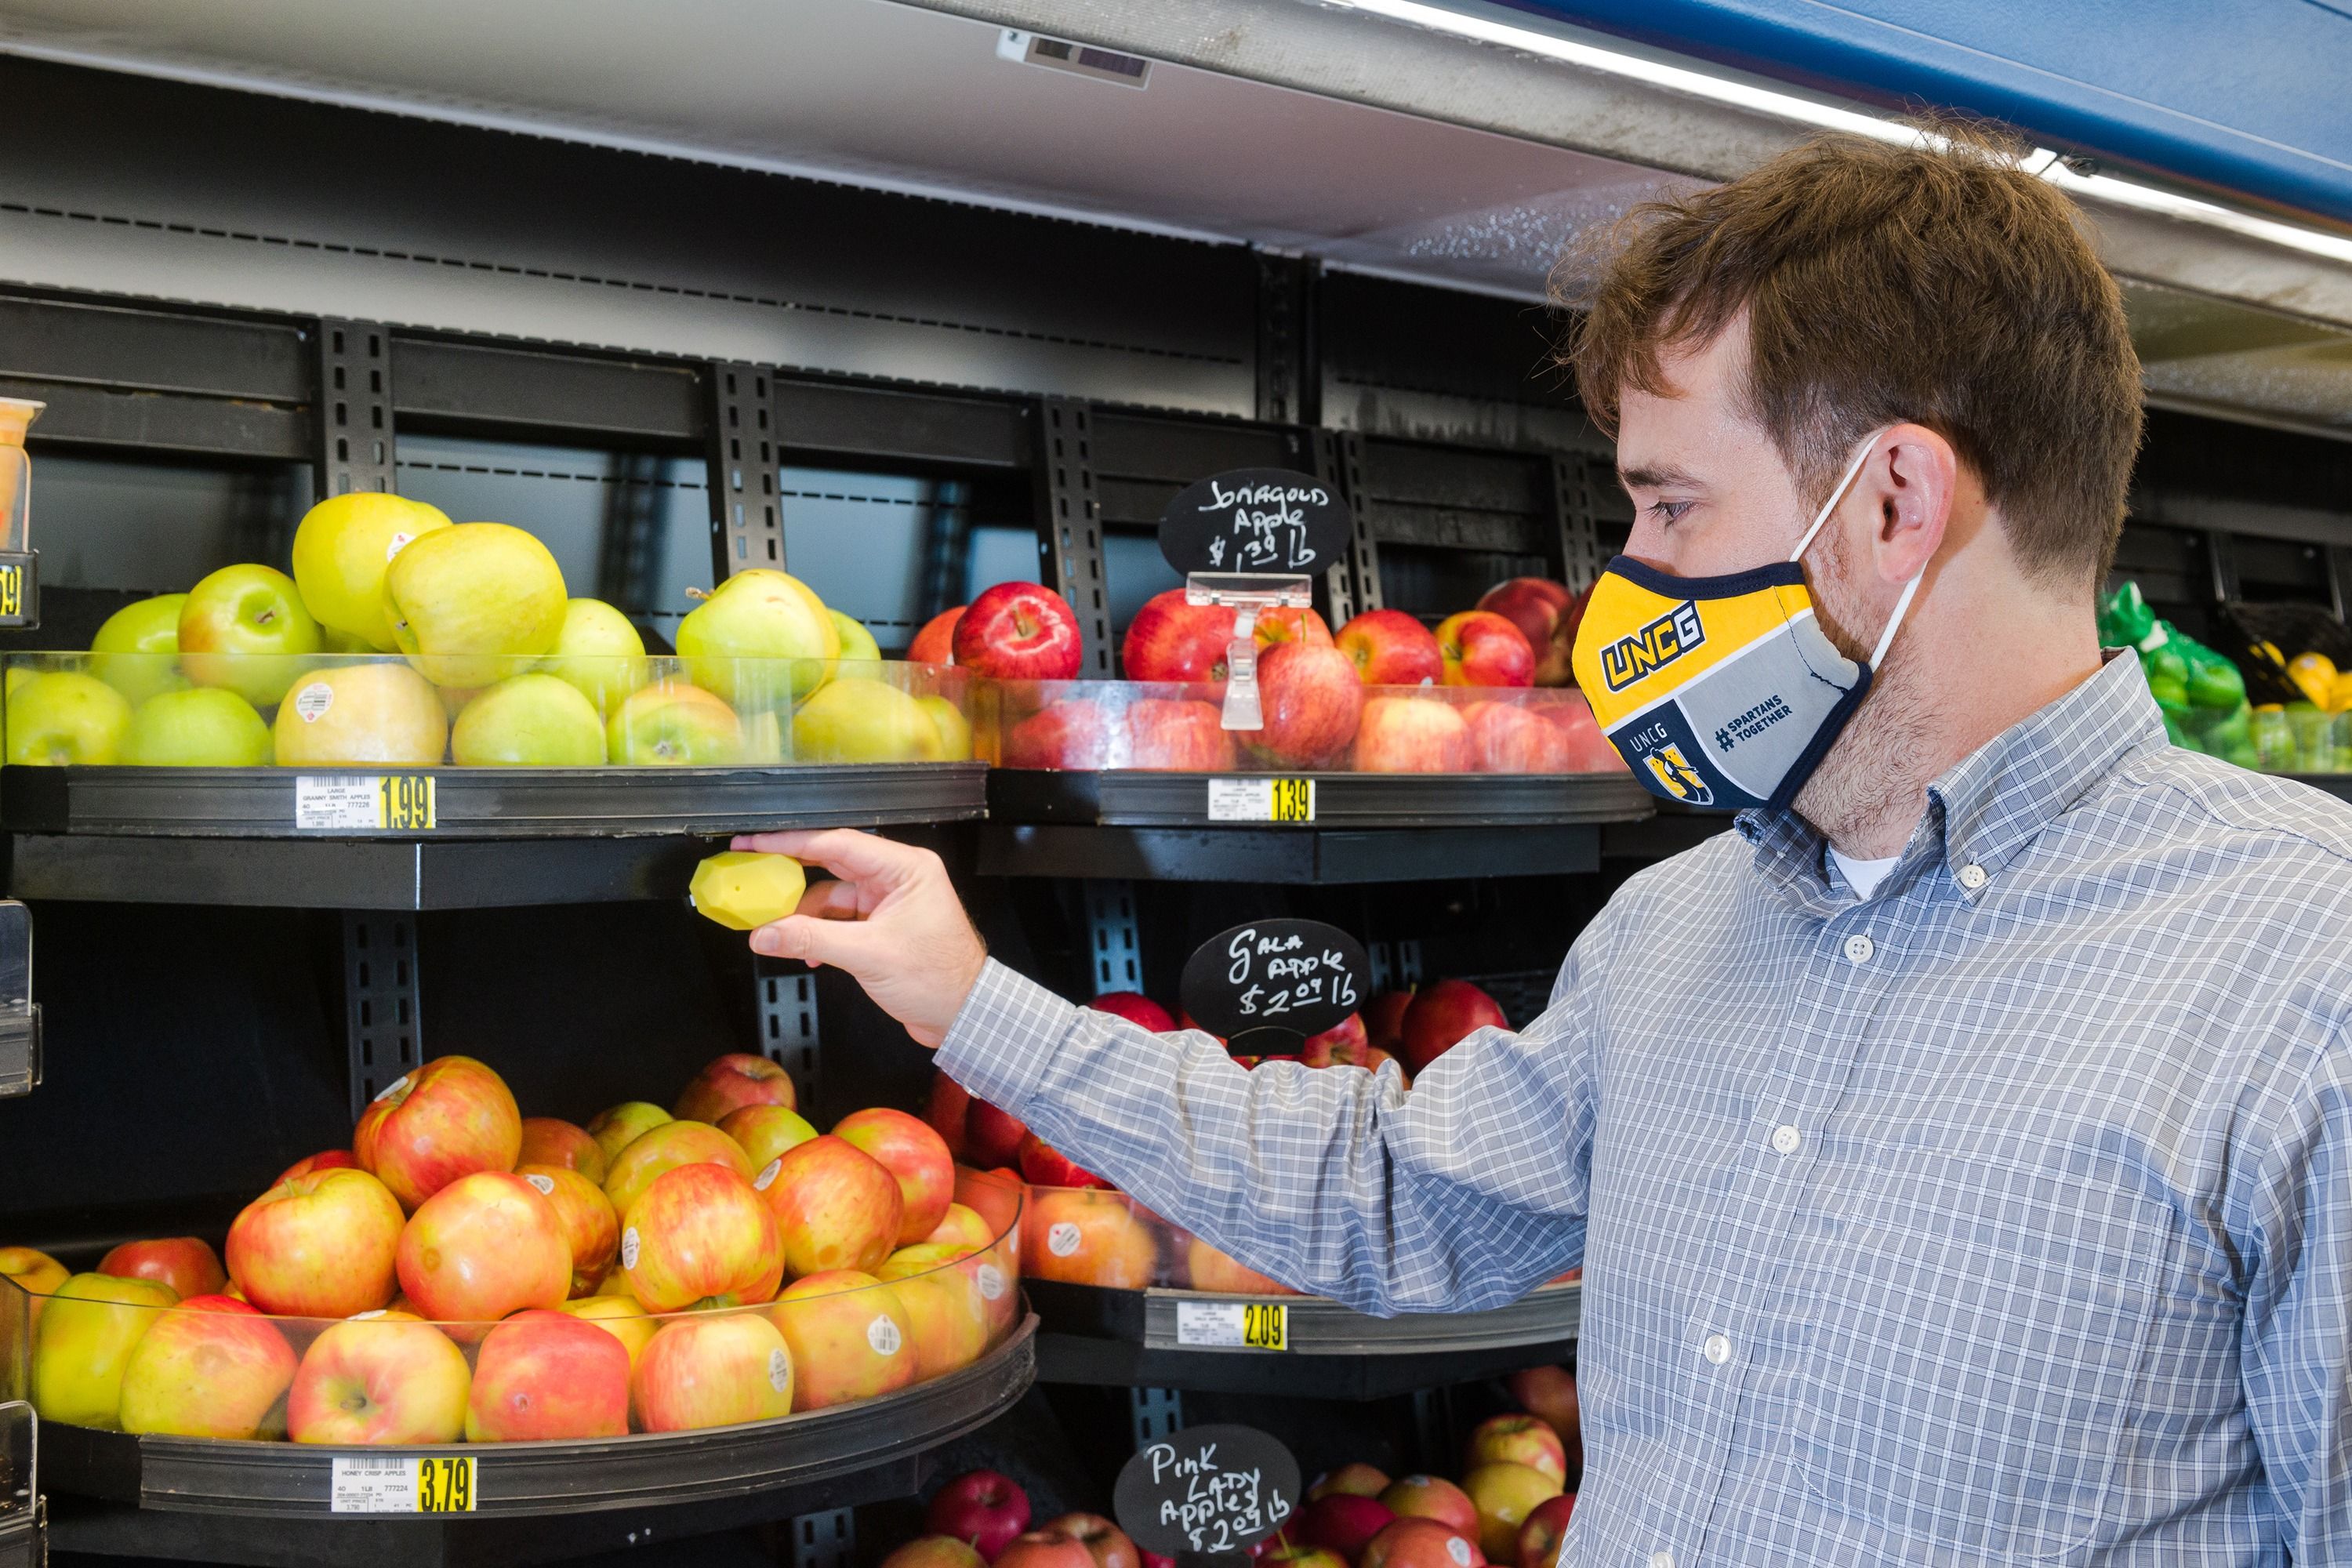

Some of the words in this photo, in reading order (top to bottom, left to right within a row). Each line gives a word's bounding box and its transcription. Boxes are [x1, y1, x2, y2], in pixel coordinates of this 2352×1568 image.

[1603, 602, 1704, 690] UNCG
[1629, 722, 1668, 753] UNCG
[1735, 705, 1793, 742] TOGETHER
[382, 776, 428, 829] 1.99
[1274, 779, 1308, 821] 1.39
[1245, 1305, 1282, 1345] 2.09
[421, 1458, 469, 1512] 3.79
